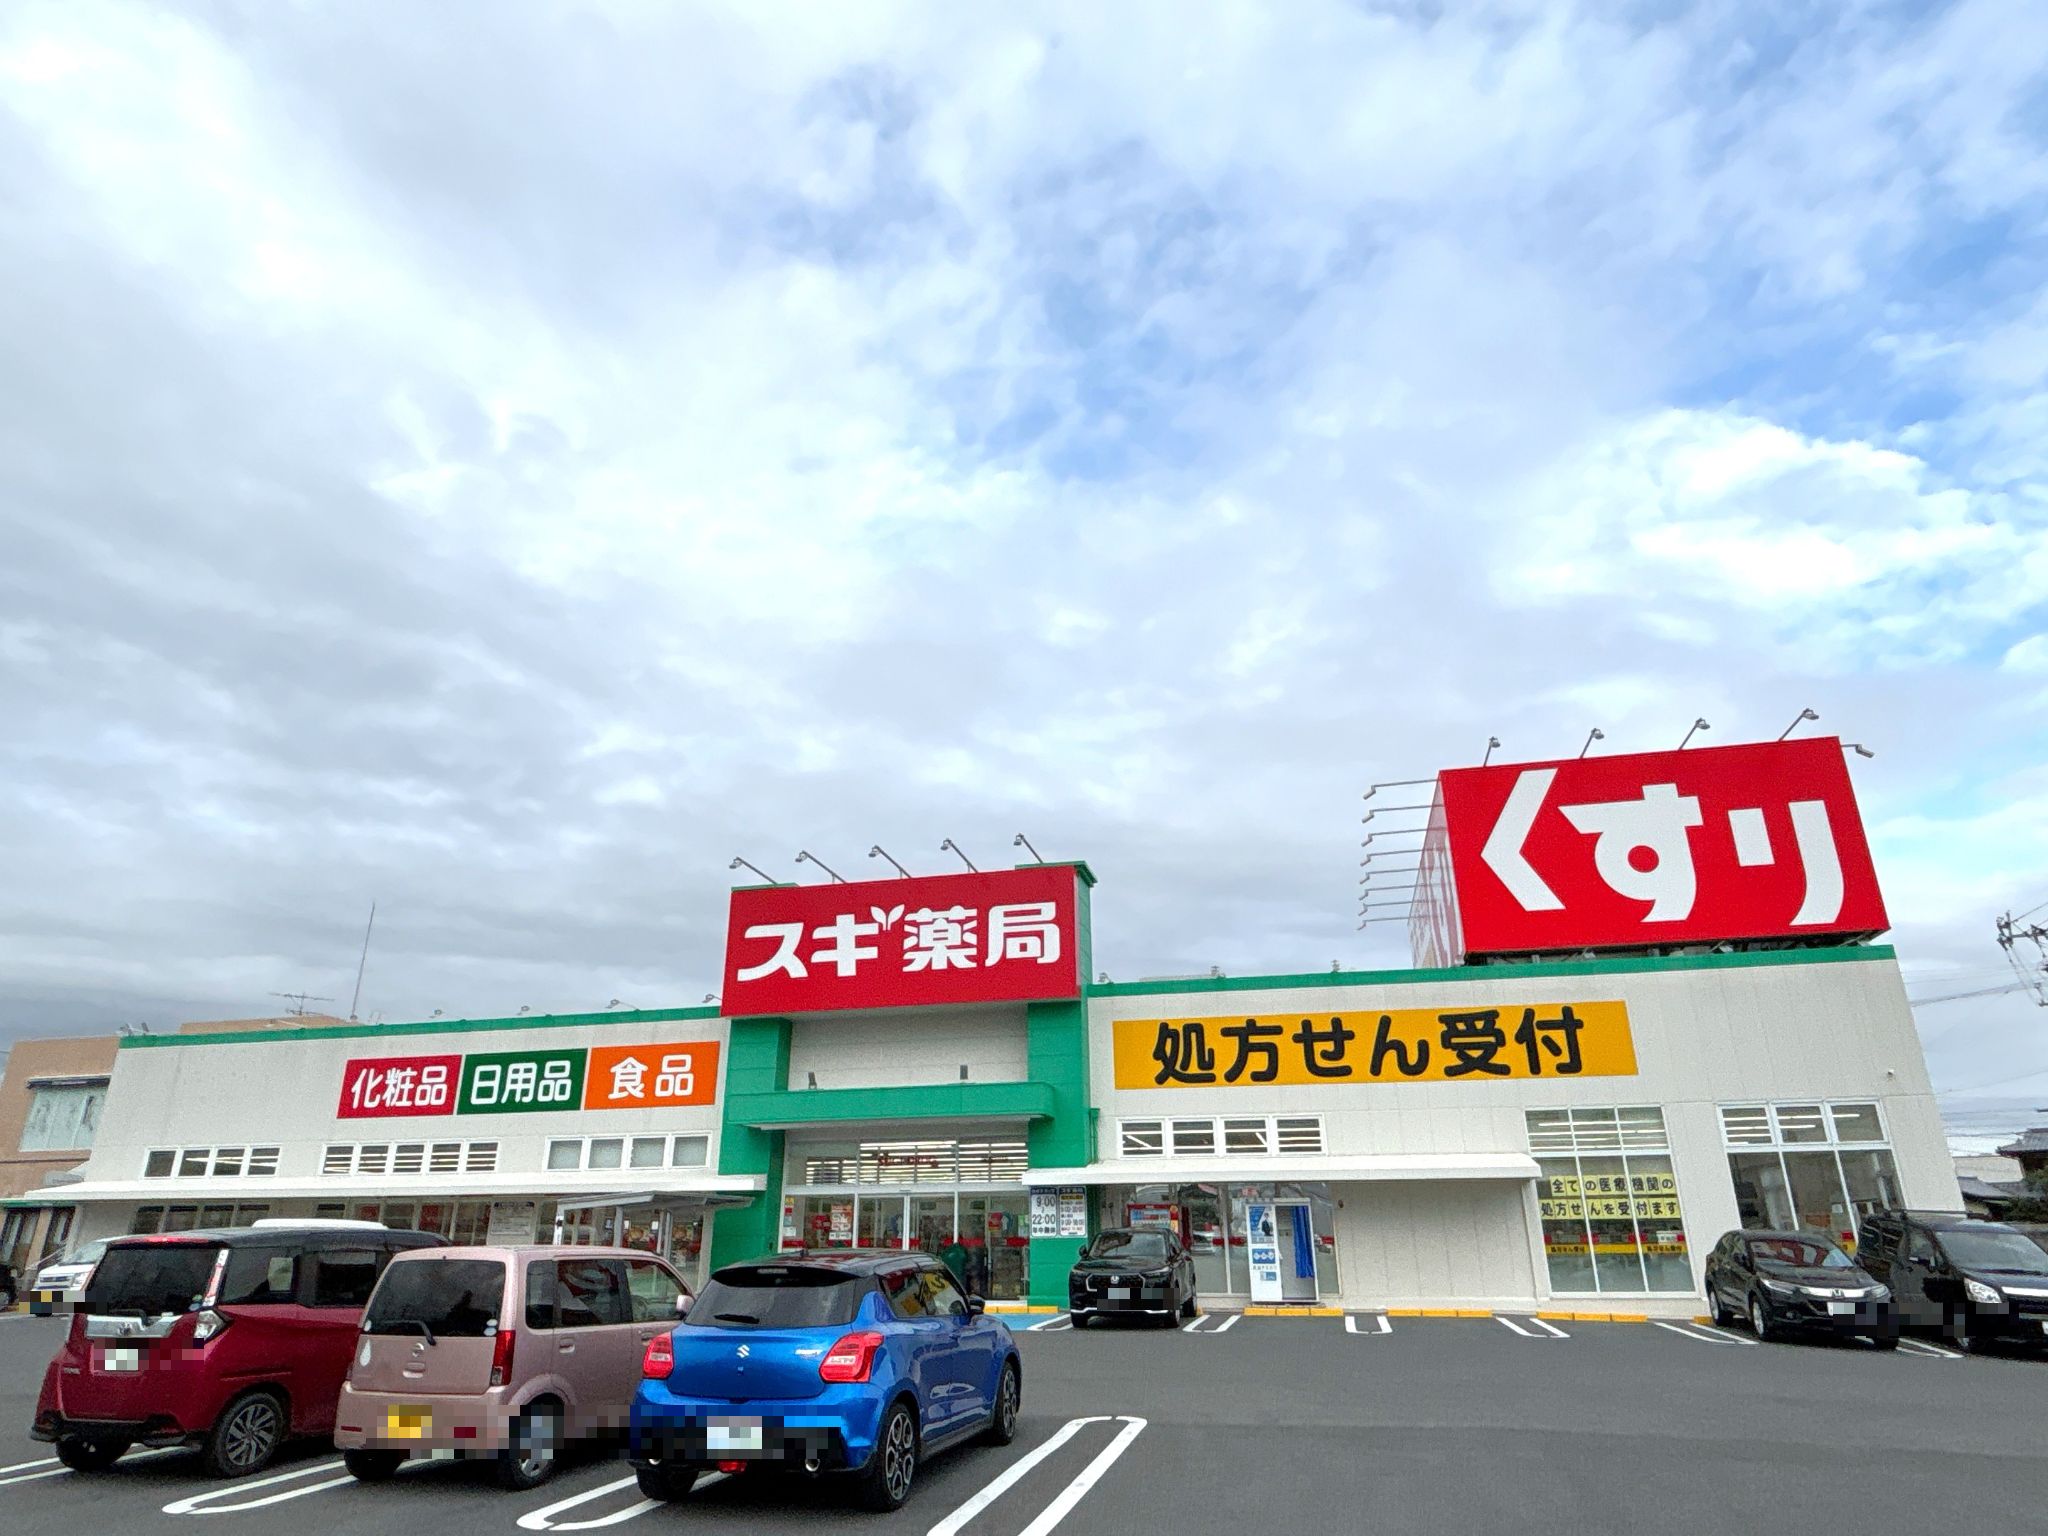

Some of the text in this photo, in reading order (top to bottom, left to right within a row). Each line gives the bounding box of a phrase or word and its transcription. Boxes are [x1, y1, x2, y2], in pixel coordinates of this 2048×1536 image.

[1480, 768, 1845, 926] くすり
[737, 901, 1061, 982] スギ薬局
[1152, 1005, 1584, 1085] 処方せん受付
[351, 1066, 447, 1109] 化粧品
[470, 1059, 572, 1105] 日用品
[608, 1053, 694, 1099] 食品
[1551, 1176, 1674, 1194] 全ての医療機関の
[1541, 1201, 1677, 1216] 処方せんを受付ます
